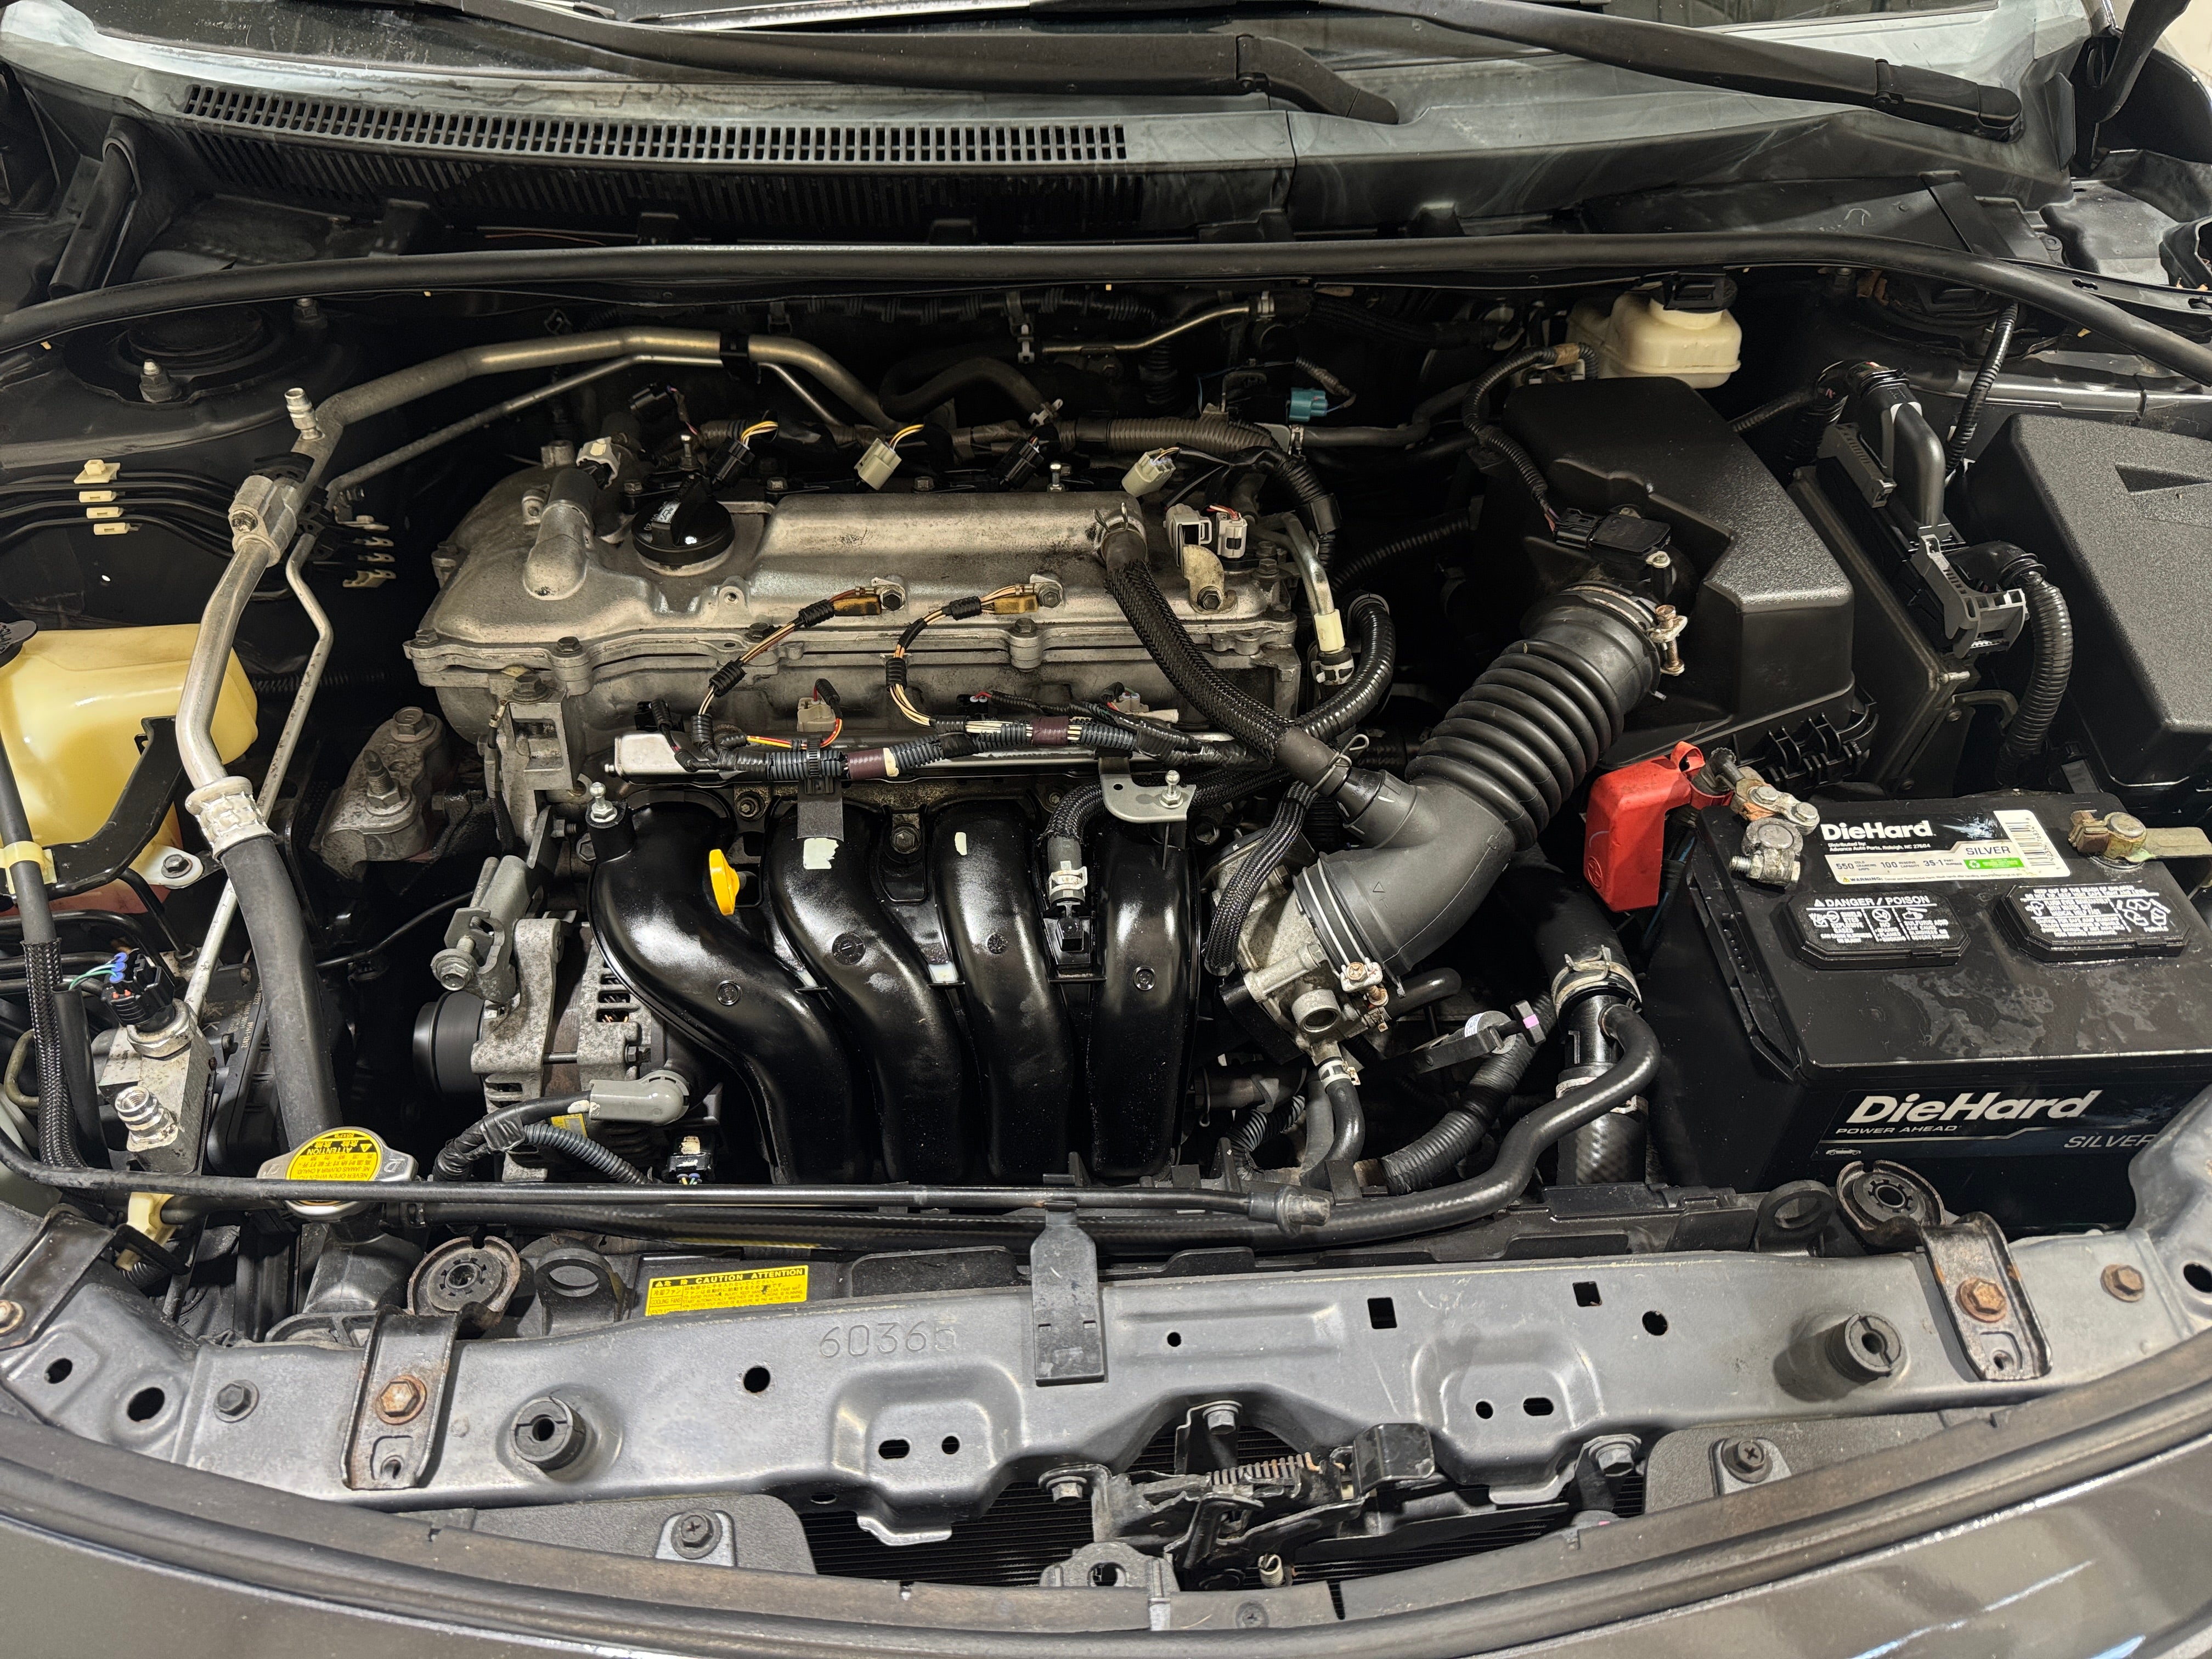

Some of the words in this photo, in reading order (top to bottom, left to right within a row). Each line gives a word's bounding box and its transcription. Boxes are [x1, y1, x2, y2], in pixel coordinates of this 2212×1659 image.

[1820, 820, 1933, 840] DieHard
[1965, 846, 2011, 855] SILVER
[1825, 898, 1875, 907] DANGER
[1876, 898, 1882, 906] /
[1886, 895, 1930, 905] POISON
[1846, 1090, 2103, 1124] DieHard
[1835, 1126, 1900, 1134] POWER
[306, 1147, 353, 1155] ATTENTION
[696, 1274, 743, 1284] CAUTION
[751, 1269, 803, 1279] ATTENTION
[820, 1318, 957, 1359] 60365
